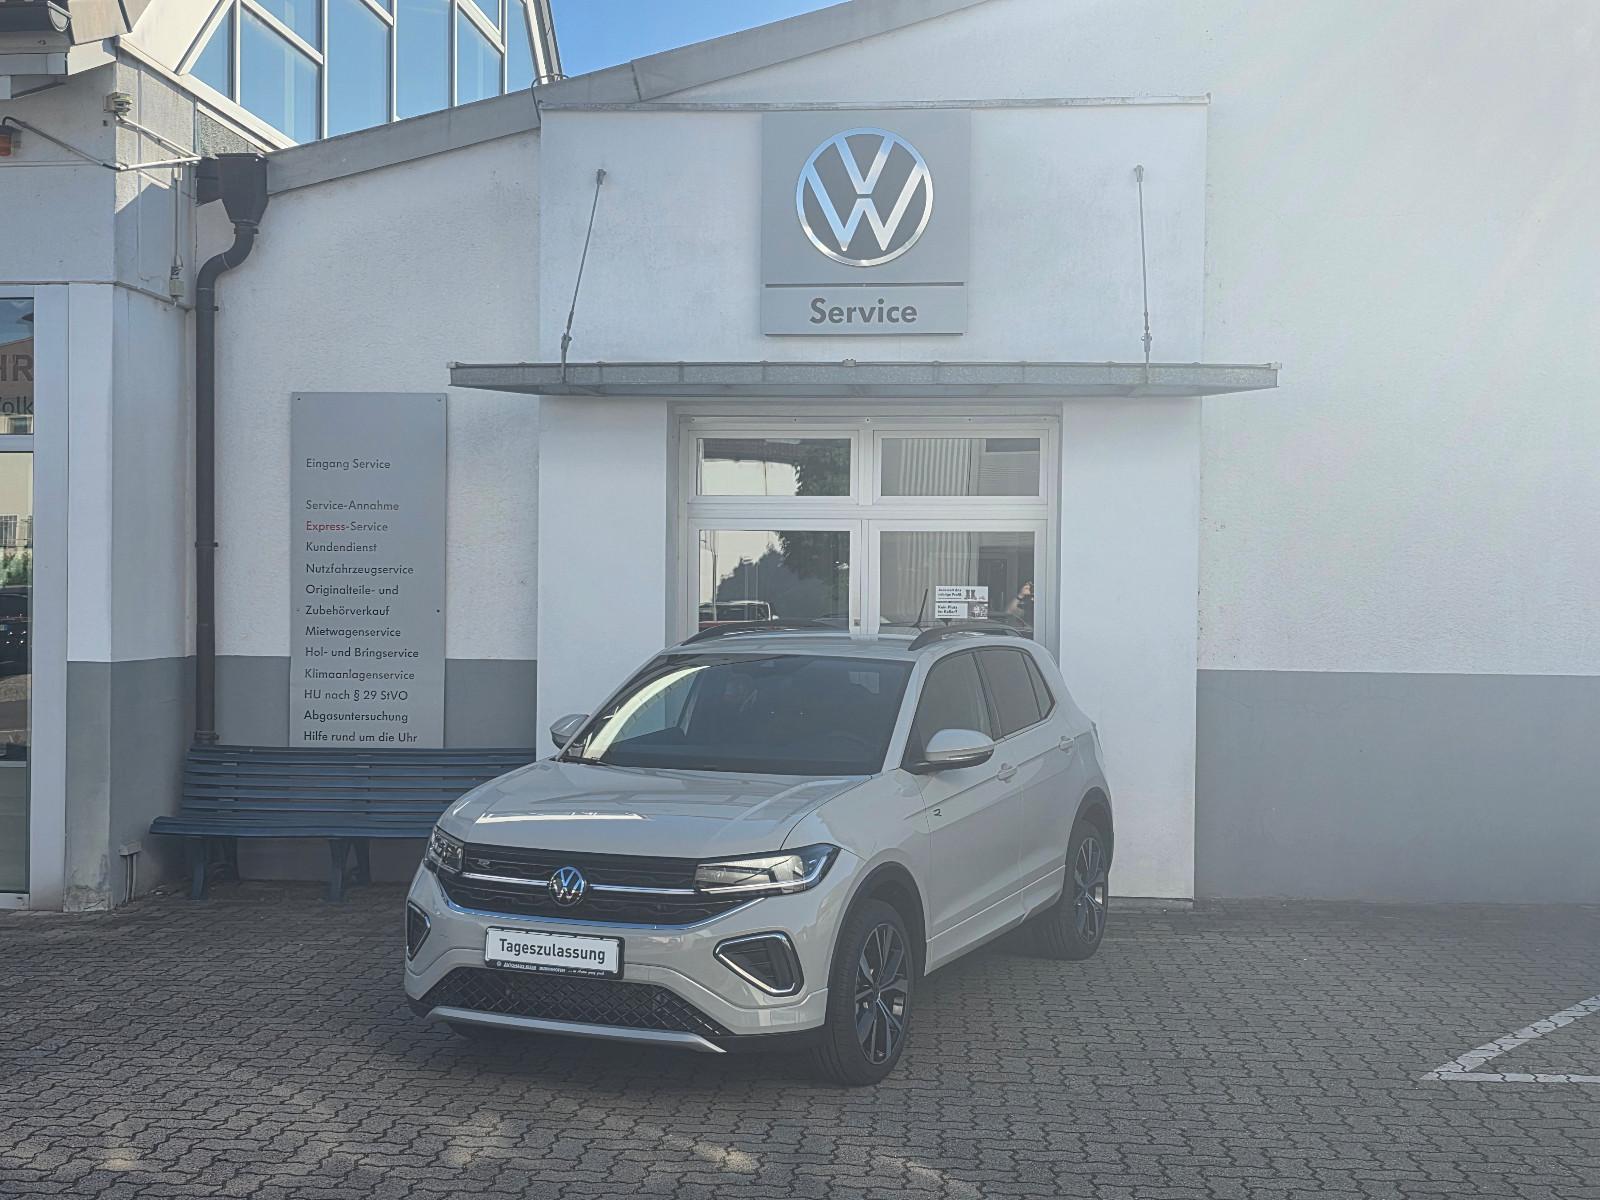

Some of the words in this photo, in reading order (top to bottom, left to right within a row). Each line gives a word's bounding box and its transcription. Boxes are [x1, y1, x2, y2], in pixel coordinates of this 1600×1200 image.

[809, 297, 918, 325] Service
[0, 396, 33, 416] olk
[305, 458, 350, 471] Eingang
[352, 459, 391, 470] Service
[305, 500, 400, 511] Service-Annahme
[305, 520, 389, 532] Express-Service
[305, 541, 378, 552] Kundendienst
[305, 563, 414, 577] Nutzfahrzeugservice
[305, 584, 375, 597] Originalteile-
[378, 585, 399, 595] und
[305, 605, 391, 616] Zubehörverkauf
[305, 626, 401, 639] Mietwagenservice
[305, 646, 328, 657] Hol-
[331, 646, 351, 657] und
[354, 647, 419, 660] Bringservice
[304, 668, 415, 682] Klimaanlagenservice
[304, 689, 321, 700] HU
[324, 689, 350, 700] nach
[353, 689, 360, 702] §
[363, 690, 377, 700] 29
[380, 690, 408, 701] StVO
[303, 710, 409, 724] Abgasuntersuchung
[304, 730, 328, 741] Hilfe
[331, 731, 356, 742] rund
[359, 734, 375, 742] um
[378, 731, 395, 742] die
[398, 732, 418, 743] Uhr
[499, 938, 606, 964] Tageszulassung
